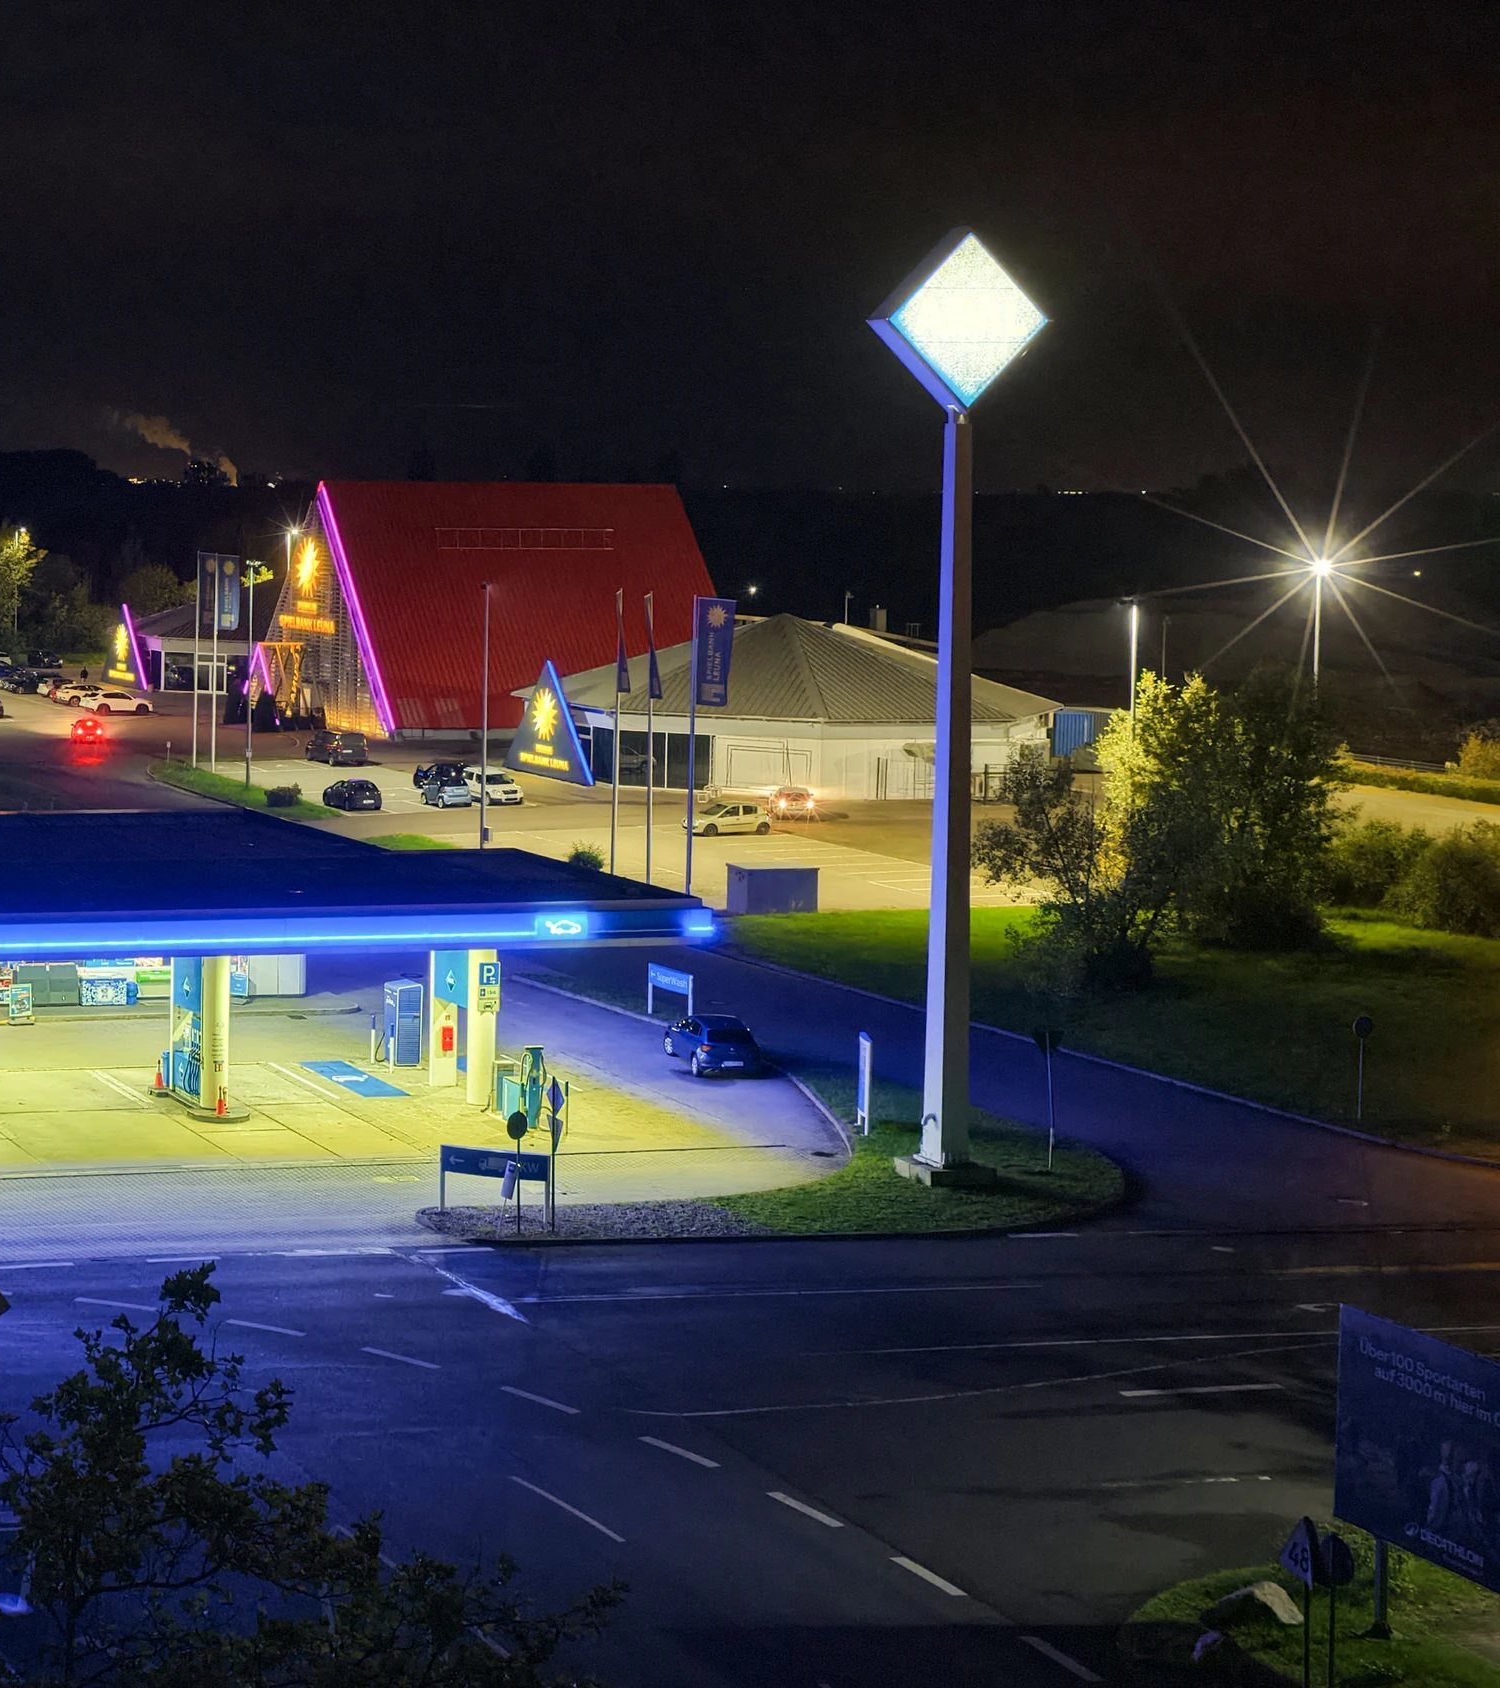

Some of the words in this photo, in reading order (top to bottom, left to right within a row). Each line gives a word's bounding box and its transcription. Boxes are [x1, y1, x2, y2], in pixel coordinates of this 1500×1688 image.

[706, 631, 715, 681] SPIELBANK
[713, 651, 721, 681] LEUNA
[483, 965, 495, 983] P
[656, 971, 688, 988] SuperWash
[1374, 1365, 1396, 1383] auf
[1396, 1372, 1432, 1398] 3000
[1450, 1392, 1473, 1415] hier
[1476, 1403, 1492, 1423] im
[1391, 1351, 1414, 1373] 100
[1415, 1361, 1486, 1402] Sportarten
[1288, 1542, 1309, 1573] 48
[1420, 1528, 1484, 1568] DECATHLON
